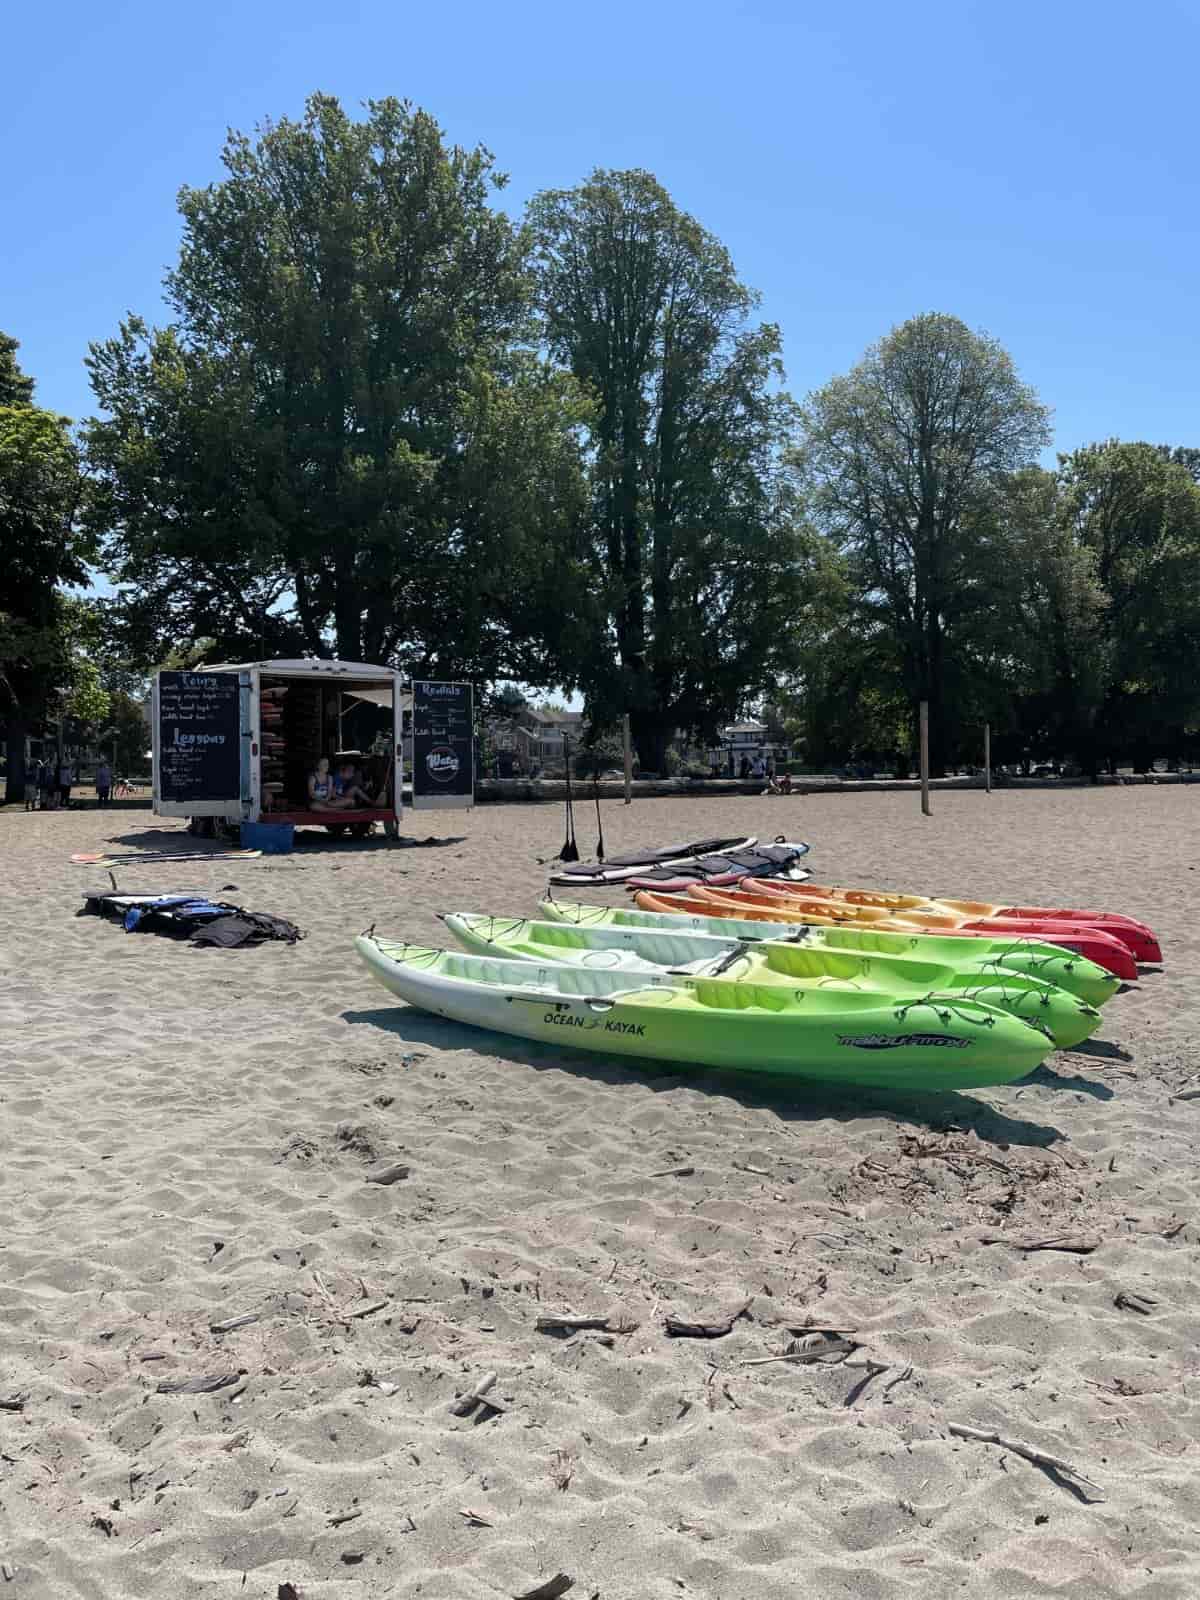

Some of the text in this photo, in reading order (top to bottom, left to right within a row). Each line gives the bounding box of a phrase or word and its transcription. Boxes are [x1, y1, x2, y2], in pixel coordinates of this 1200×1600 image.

[422, 683, 461, 697] Rentals
[173, 727, 225, 746] Lessons
[543, 1013, 647, 1036] OCEAN KAYAK
